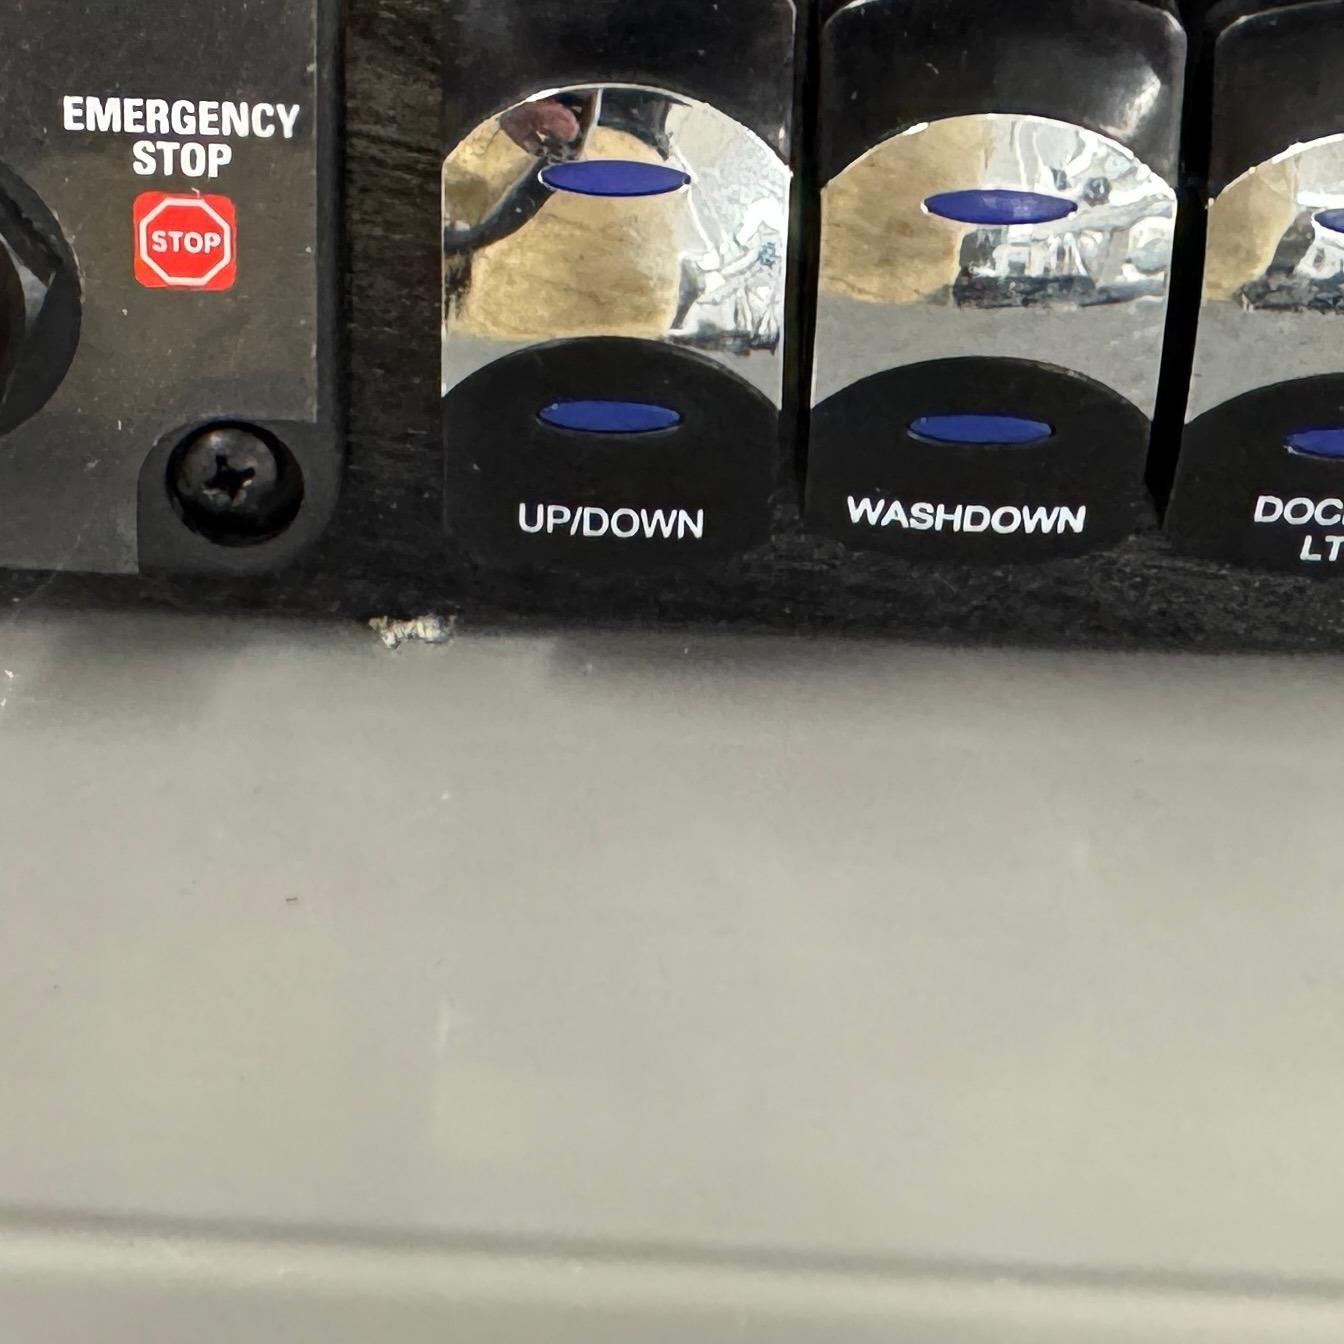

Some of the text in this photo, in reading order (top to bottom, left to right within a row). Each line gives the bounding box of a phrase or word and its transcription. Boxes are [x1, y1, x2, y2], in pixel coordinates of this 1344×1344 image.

[62, 95, 300, 139] EMERGENCY
[132, 140, 232, 178] STOP
[150, 229, 221, 257] STOP
[518, 502, 704, 539] UP/DOWN
[847, 495, 1087, 534] WASHDOWN
